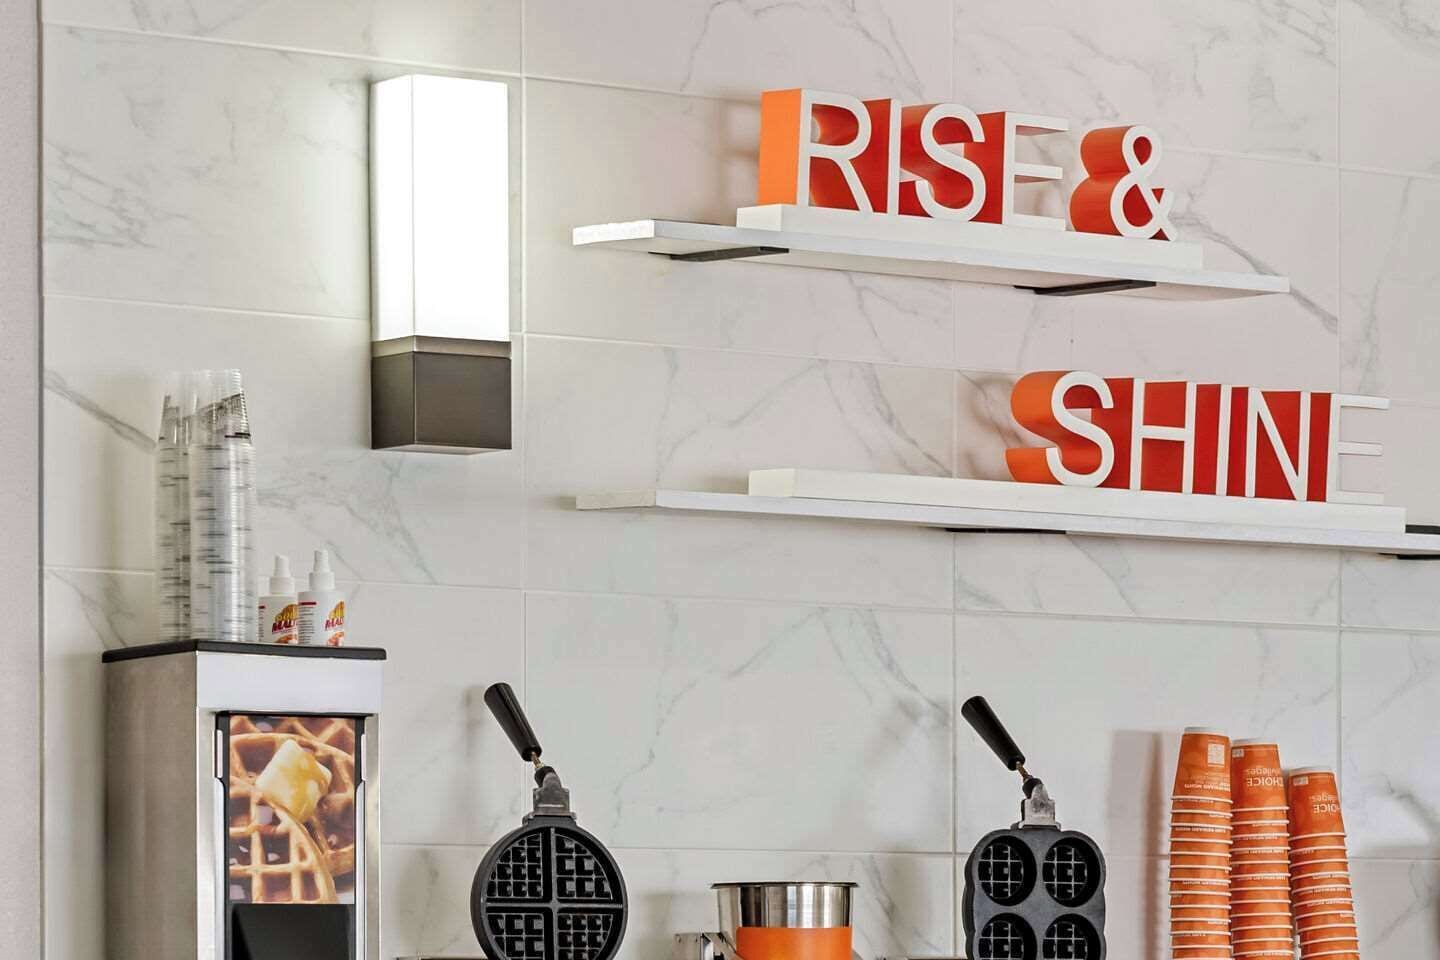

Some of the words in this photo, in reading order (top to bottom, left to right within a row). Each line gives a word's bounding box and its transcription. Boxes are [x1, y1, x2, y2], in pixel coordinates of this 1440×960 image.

[796, 88, 1070, 232] RISE
[1106, 124, 1178, 242] &
[1046, 370, 1390, 505] SHINE
